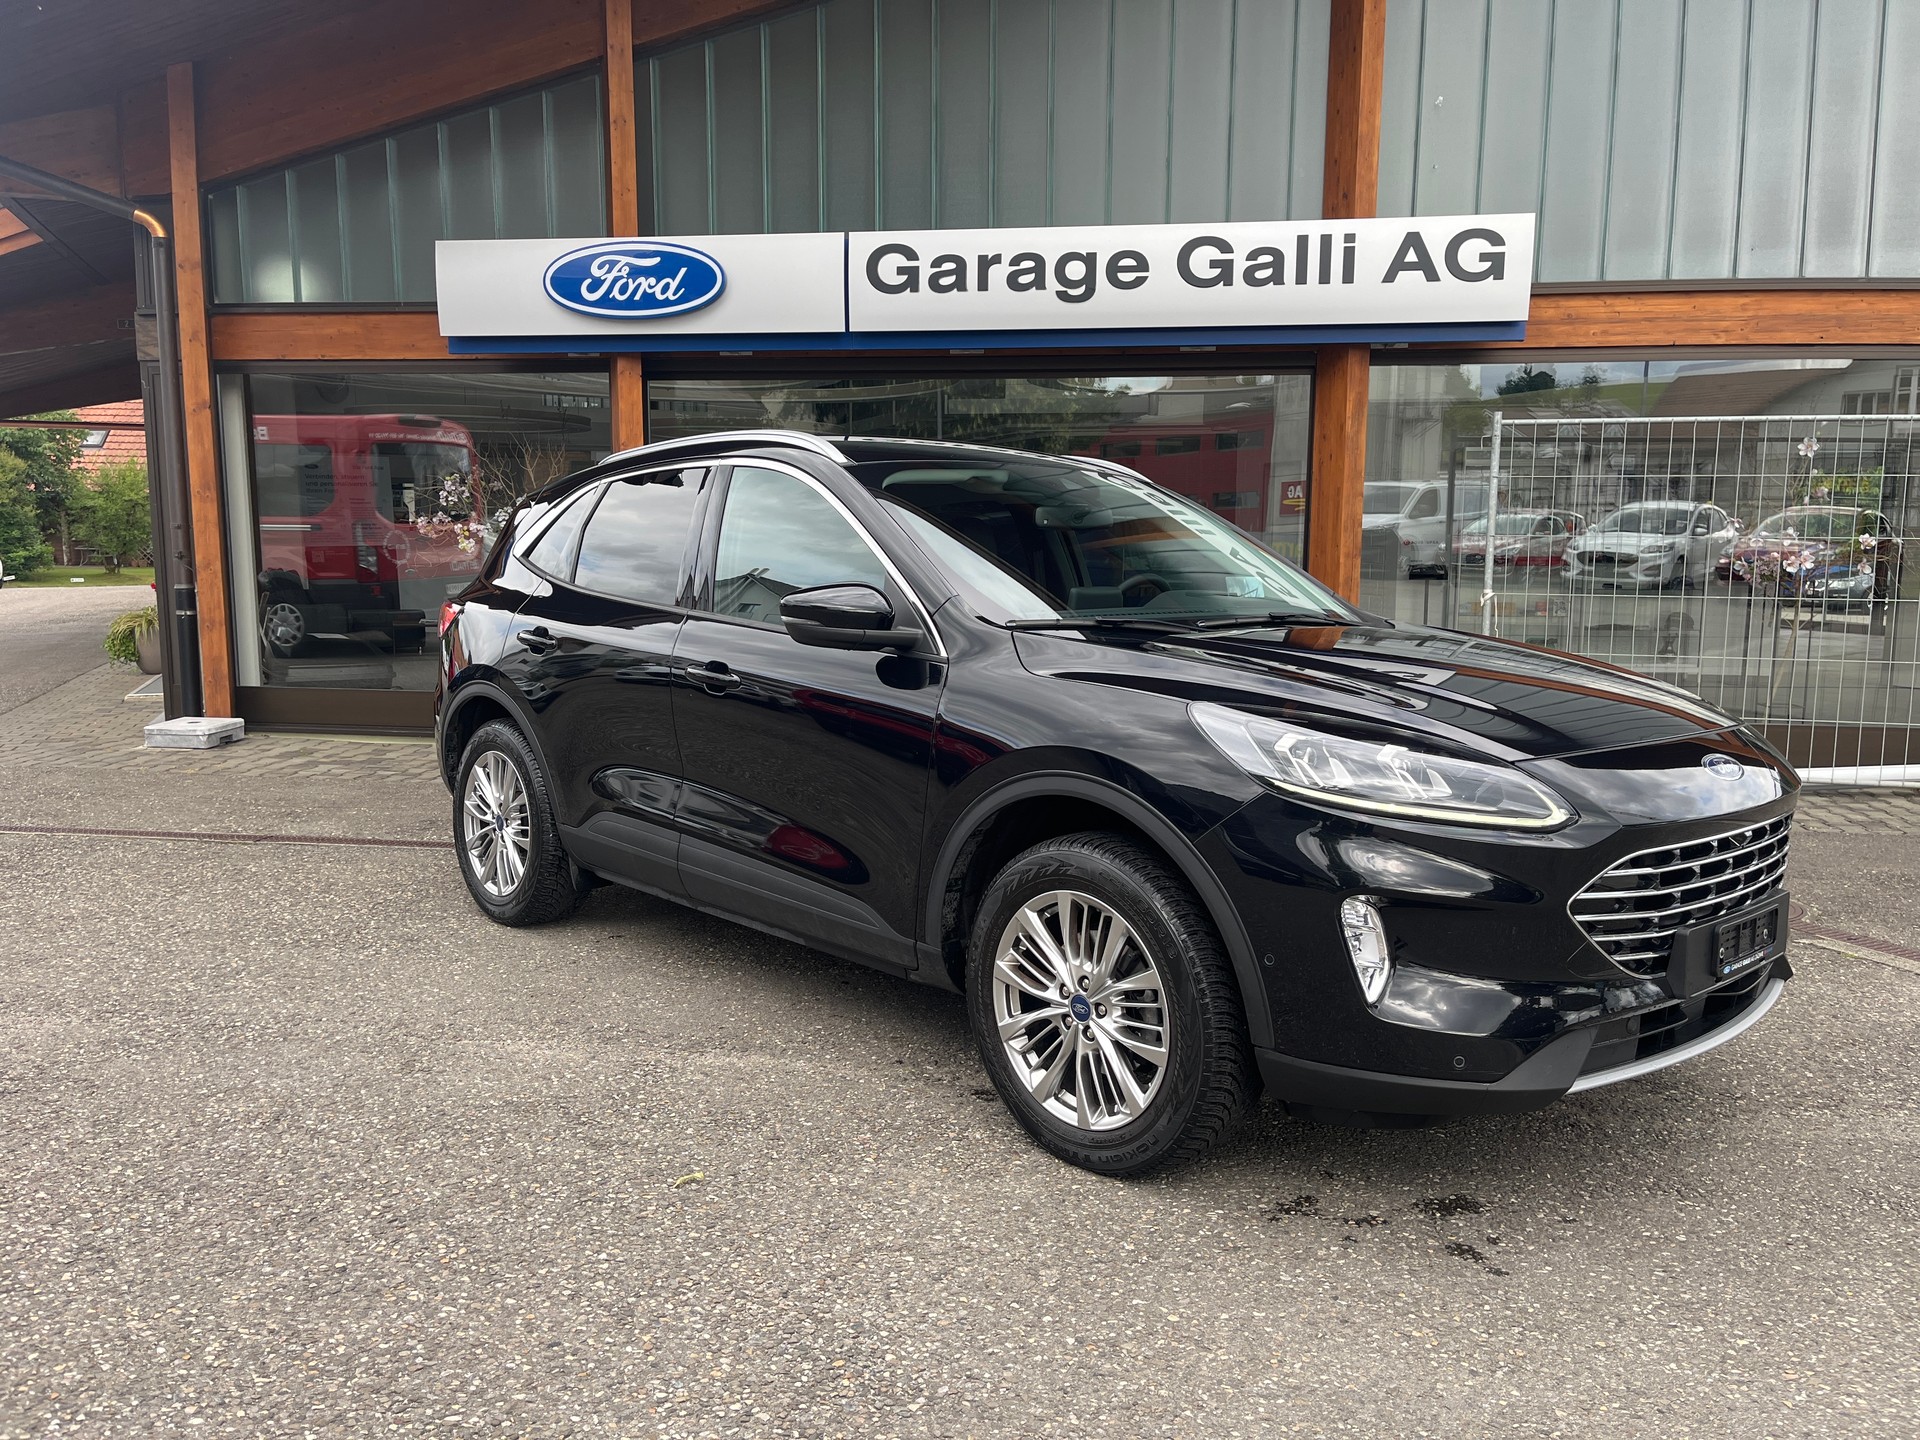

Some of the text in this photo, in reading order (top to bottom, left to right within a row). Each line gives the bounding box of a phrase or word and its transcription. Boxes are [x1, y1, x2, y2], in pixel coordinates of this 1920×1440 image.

[580, 255, 687, 301] Ford
[866, 227, 1506, 304] Garage Galli AG
